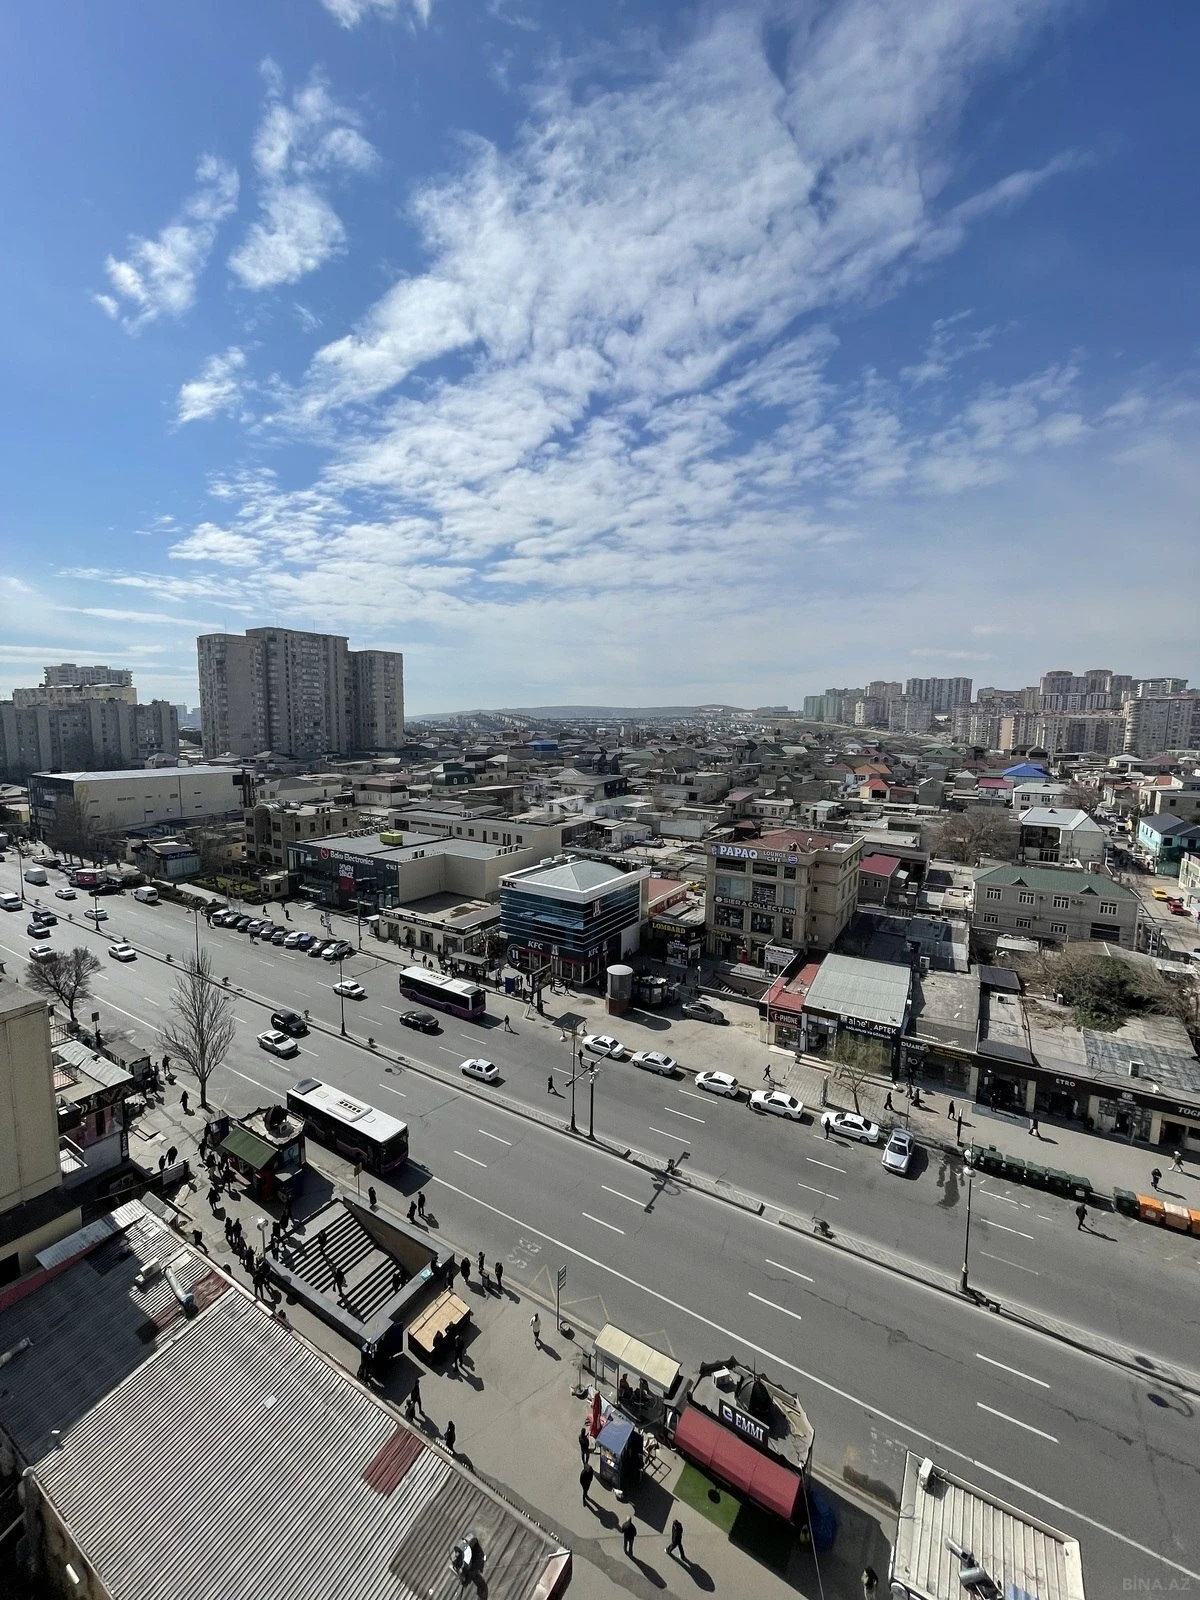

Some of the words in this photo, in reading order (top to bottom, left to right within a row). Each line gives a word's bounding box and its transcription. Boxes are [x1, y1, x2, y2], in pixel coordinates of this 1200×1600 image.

[719, 845, 758, 859] PAPAQ
[344, 853, 374, 866] Electronics
[501, 879, 517, 889] KFC
[652, 922, 686, 934] LOMBARD
[528, 940, 544, 950] KFC
[587, 946, 600, 957] KFC
[1055, 1078, 1076, 1087] ETRO
[735, 1412, 764, 1441] EMMI
